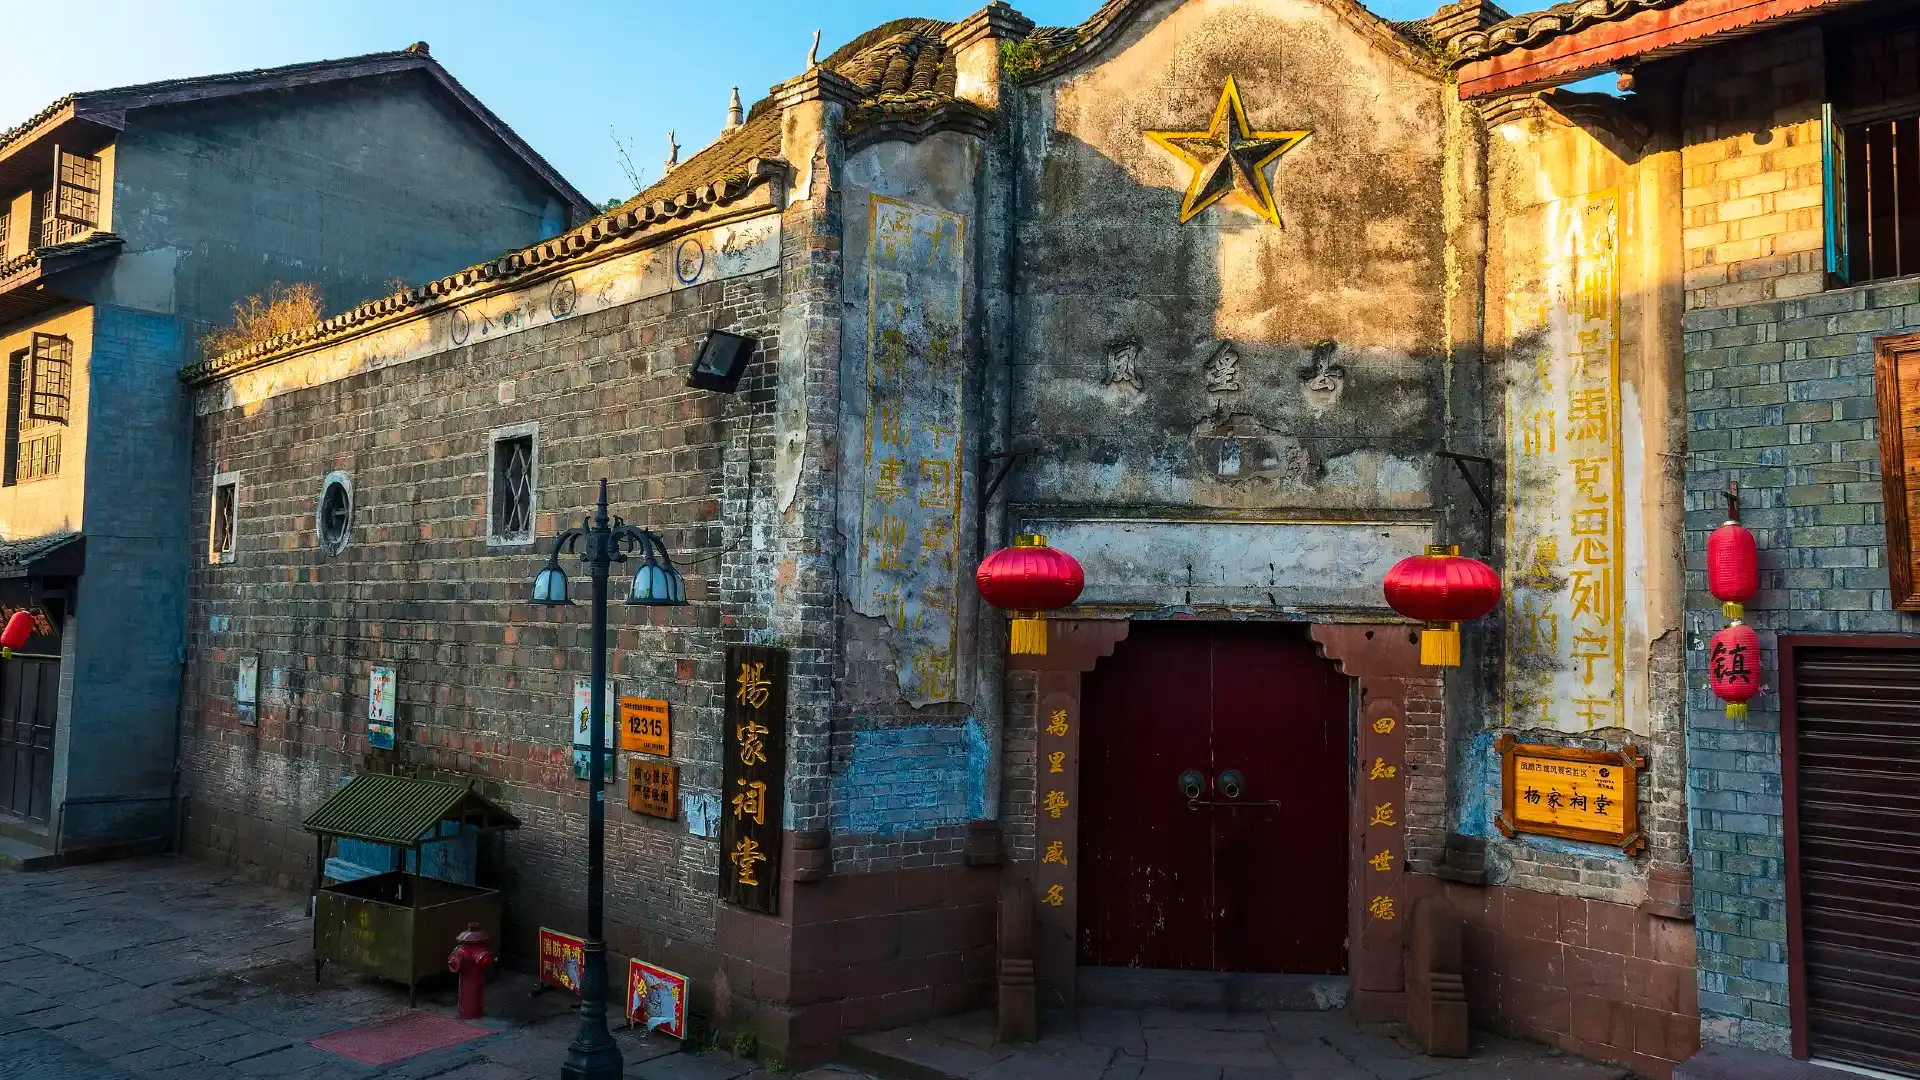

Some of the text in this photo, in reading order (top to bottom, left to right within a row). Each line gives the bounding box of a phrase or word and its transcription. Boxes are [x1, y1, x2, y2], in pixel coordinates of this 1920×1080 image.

[1711, 642, 1752, 684] 镇
[629, 716, 663, 737] 12315
[731, 662, 771, 887] 楊家祠堂
[1369, 717, 1397, 920] 四知延世德
[1523, 786, 1613, 816] 杨家祠堂
